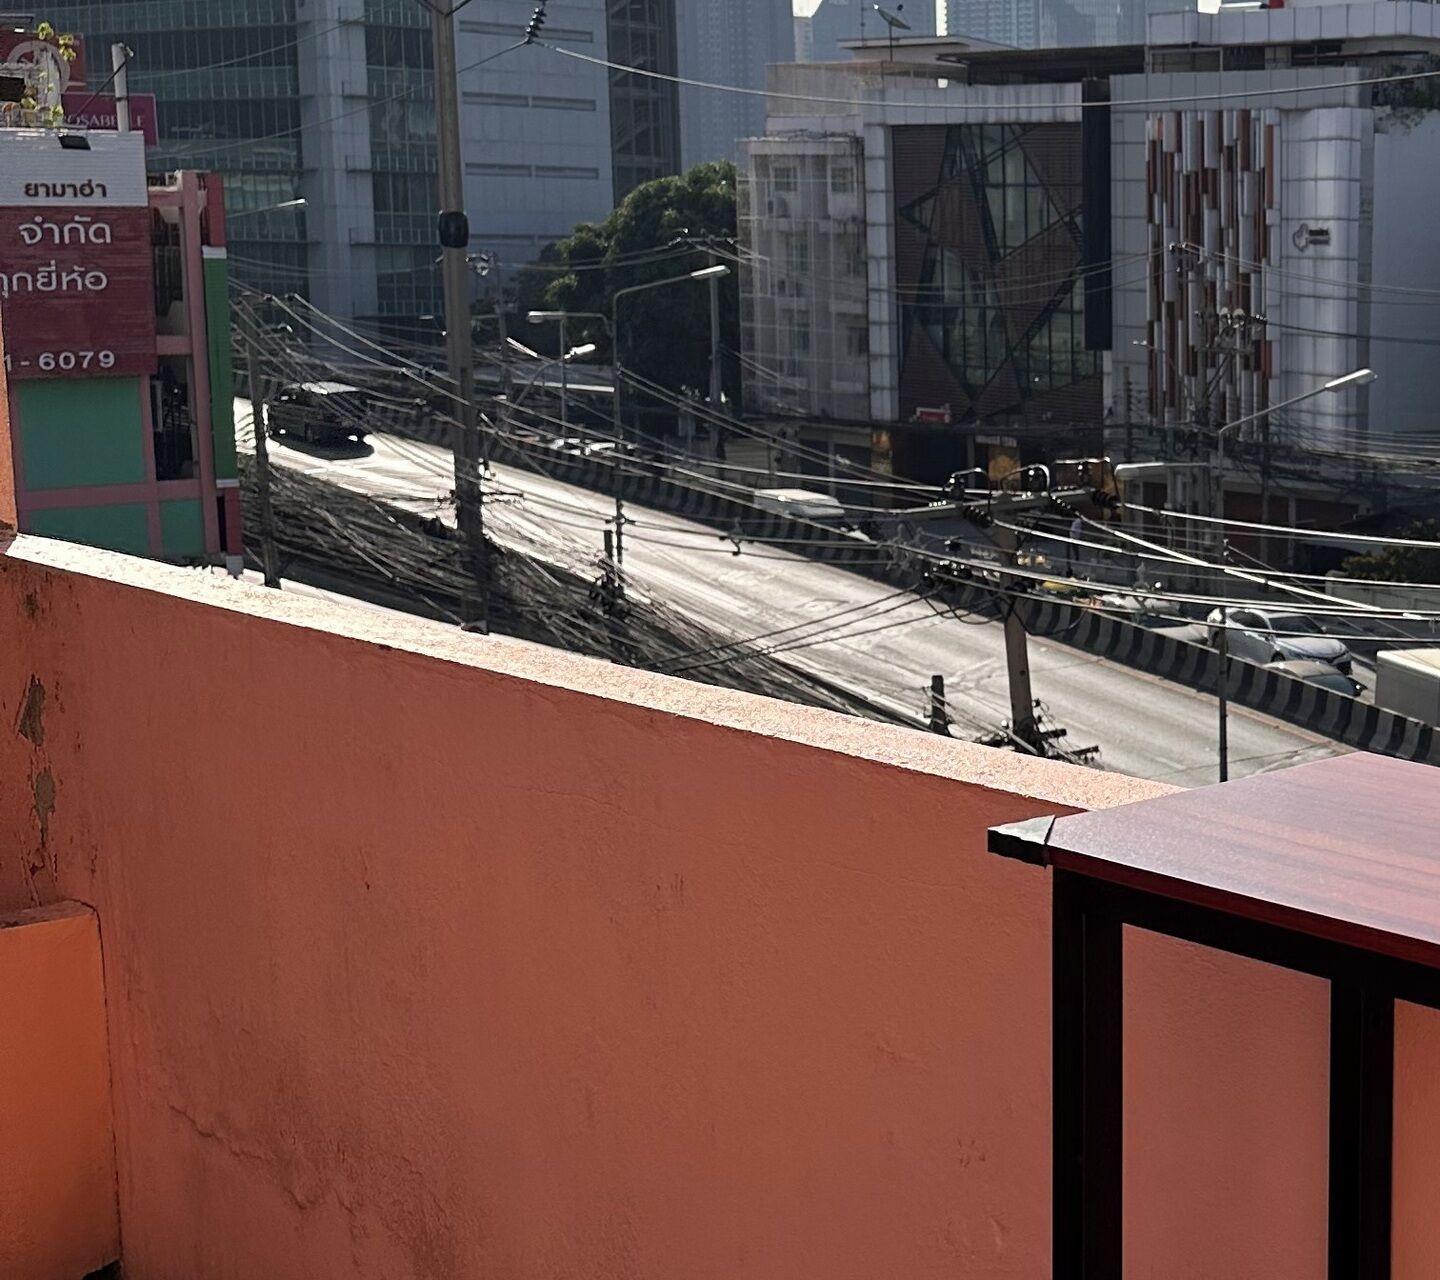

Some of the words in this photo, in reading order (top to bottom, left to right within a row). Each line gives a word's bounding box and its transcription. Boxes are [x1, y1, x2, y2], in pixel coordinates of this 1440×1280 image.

[24, 179, 107, 198] ยามาฮ่า
[19, 215, 112, 245] จำกัด
